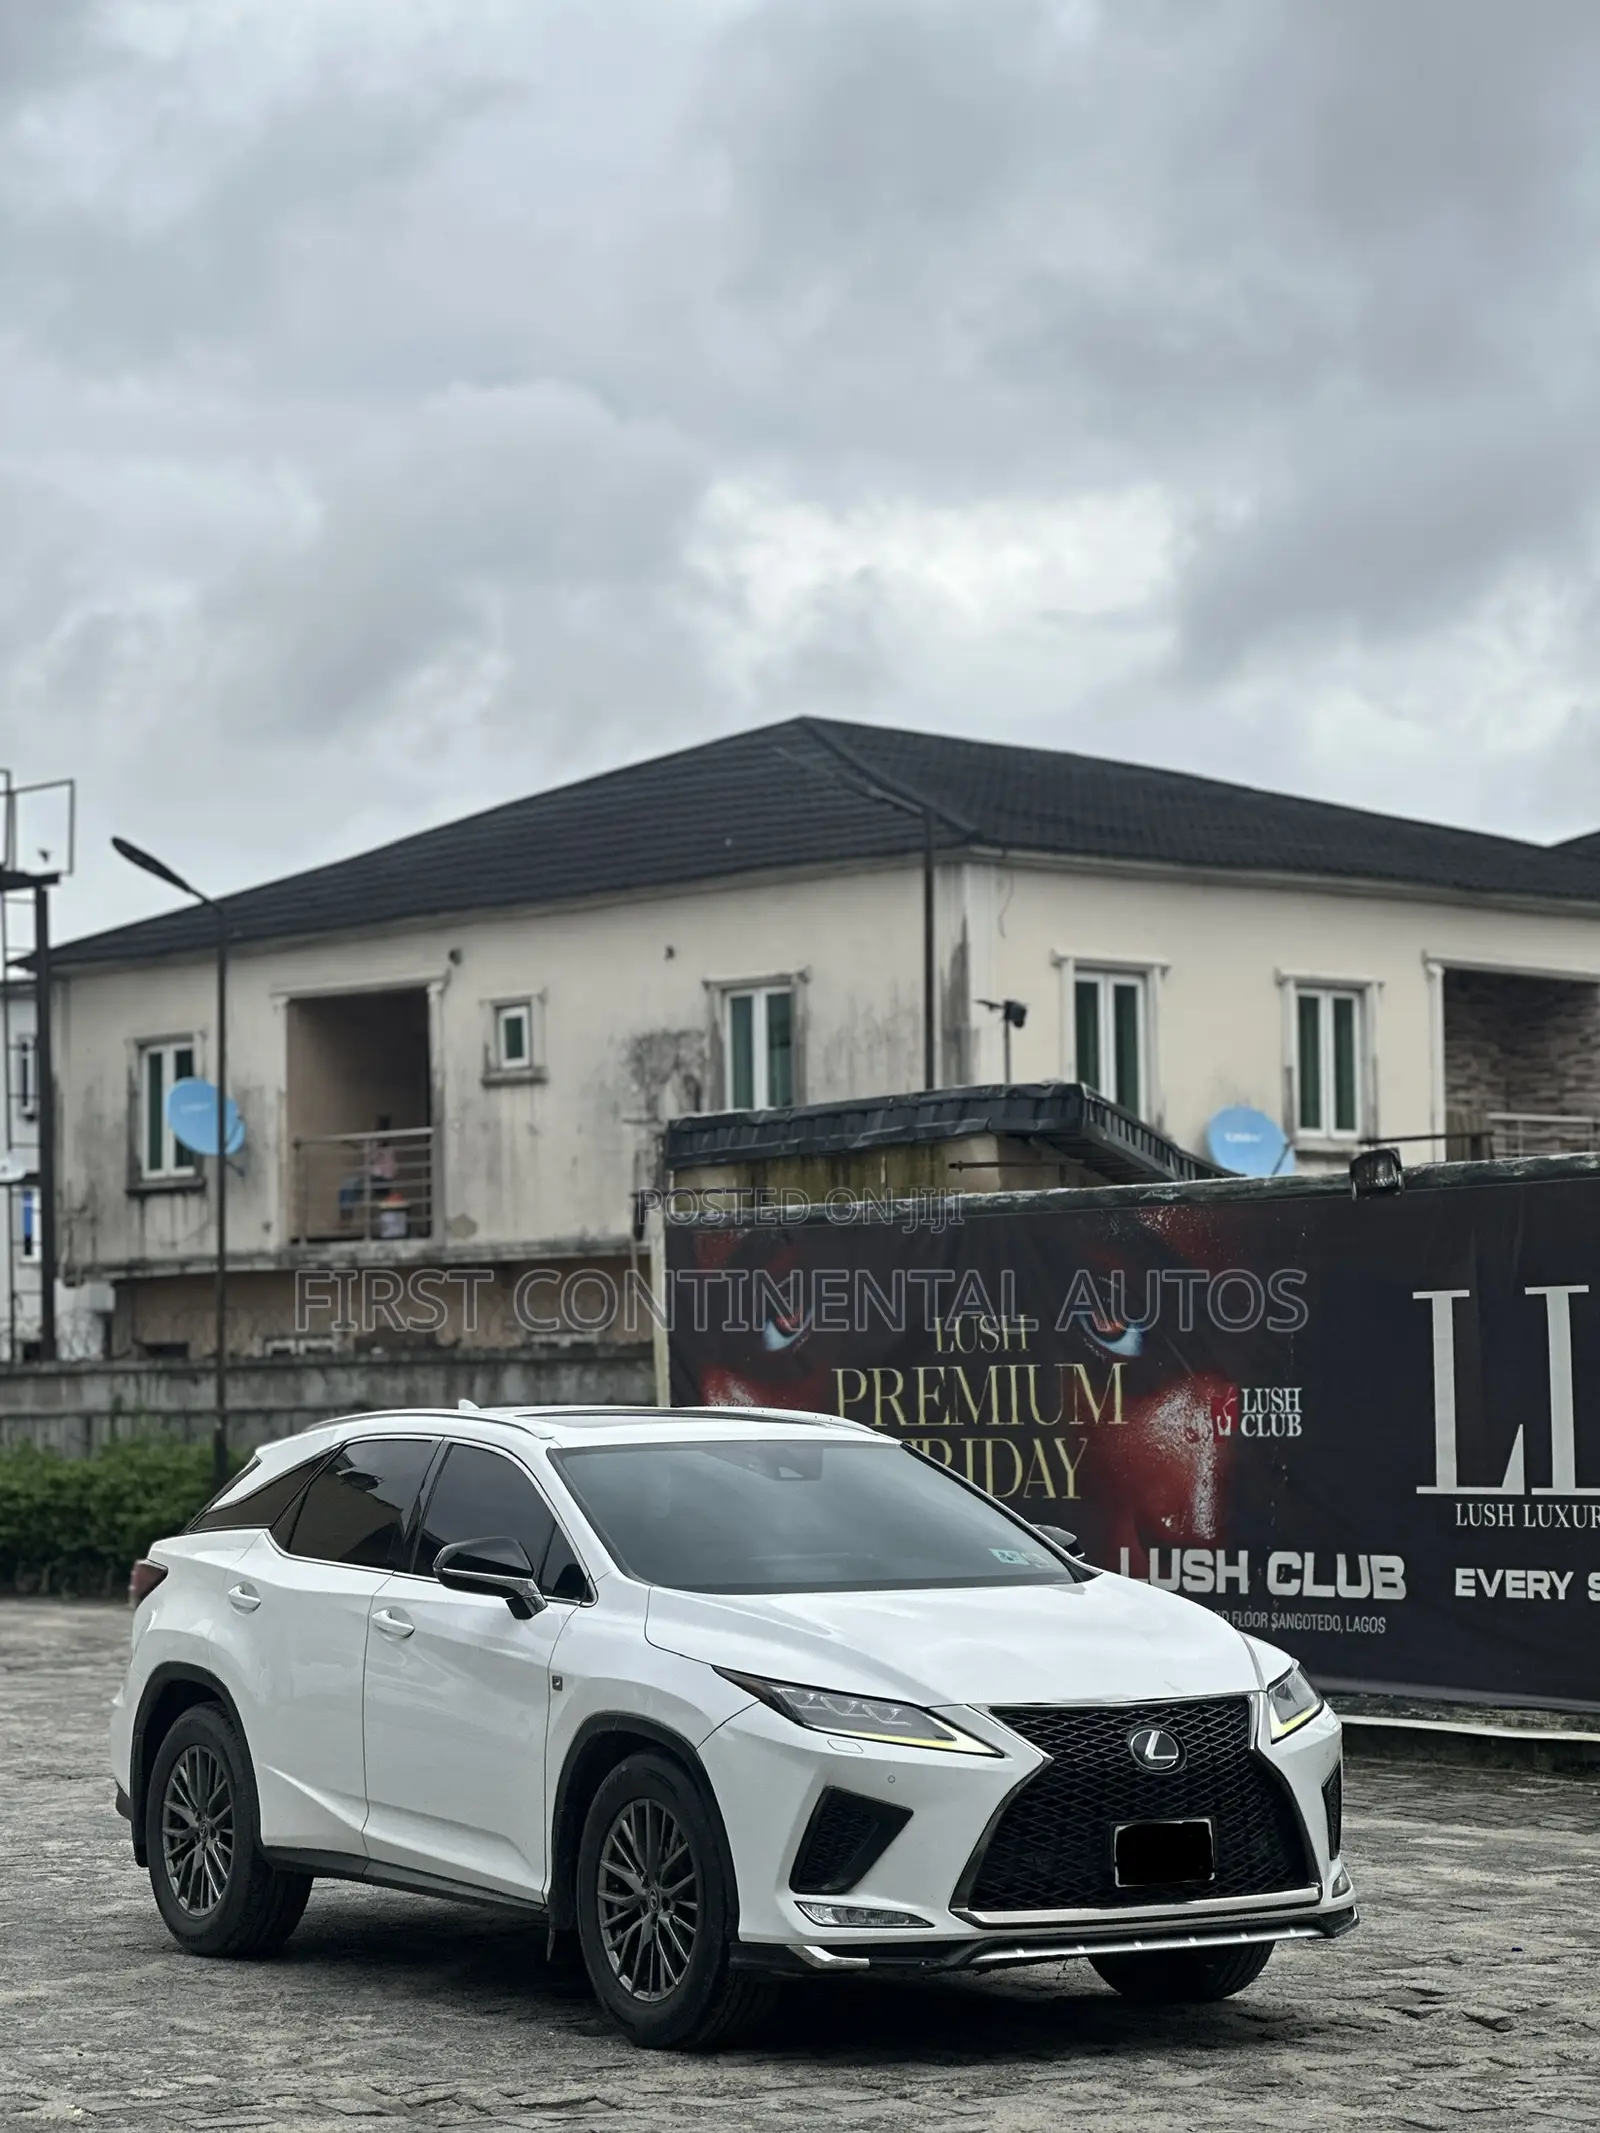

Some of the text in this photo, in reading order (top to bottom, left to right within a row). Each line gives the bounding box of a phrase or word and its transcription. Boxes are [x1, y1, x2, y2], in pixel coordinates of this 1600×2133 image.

[932, 1314, 1031, 1354] LUSH
[831, 1362, 1128, 1426] PREMIUM
[1241, 1387, 1302, 1413] LUSH
[1240, 1413, 1302, 1437] CLUB
[1455, 1503, 1515, 1527] LUSH
[1120, 1547, 1407, 1600] LUSH CLUB
[1455, 1568, 1574, 1600] EVERY
[1232, 1611, 1269, 1629] FLOOR
[1271, 1613, 1343, 1634] SANGOTEDO,
[1345, 1616, 1387, 1634] LAGOS
